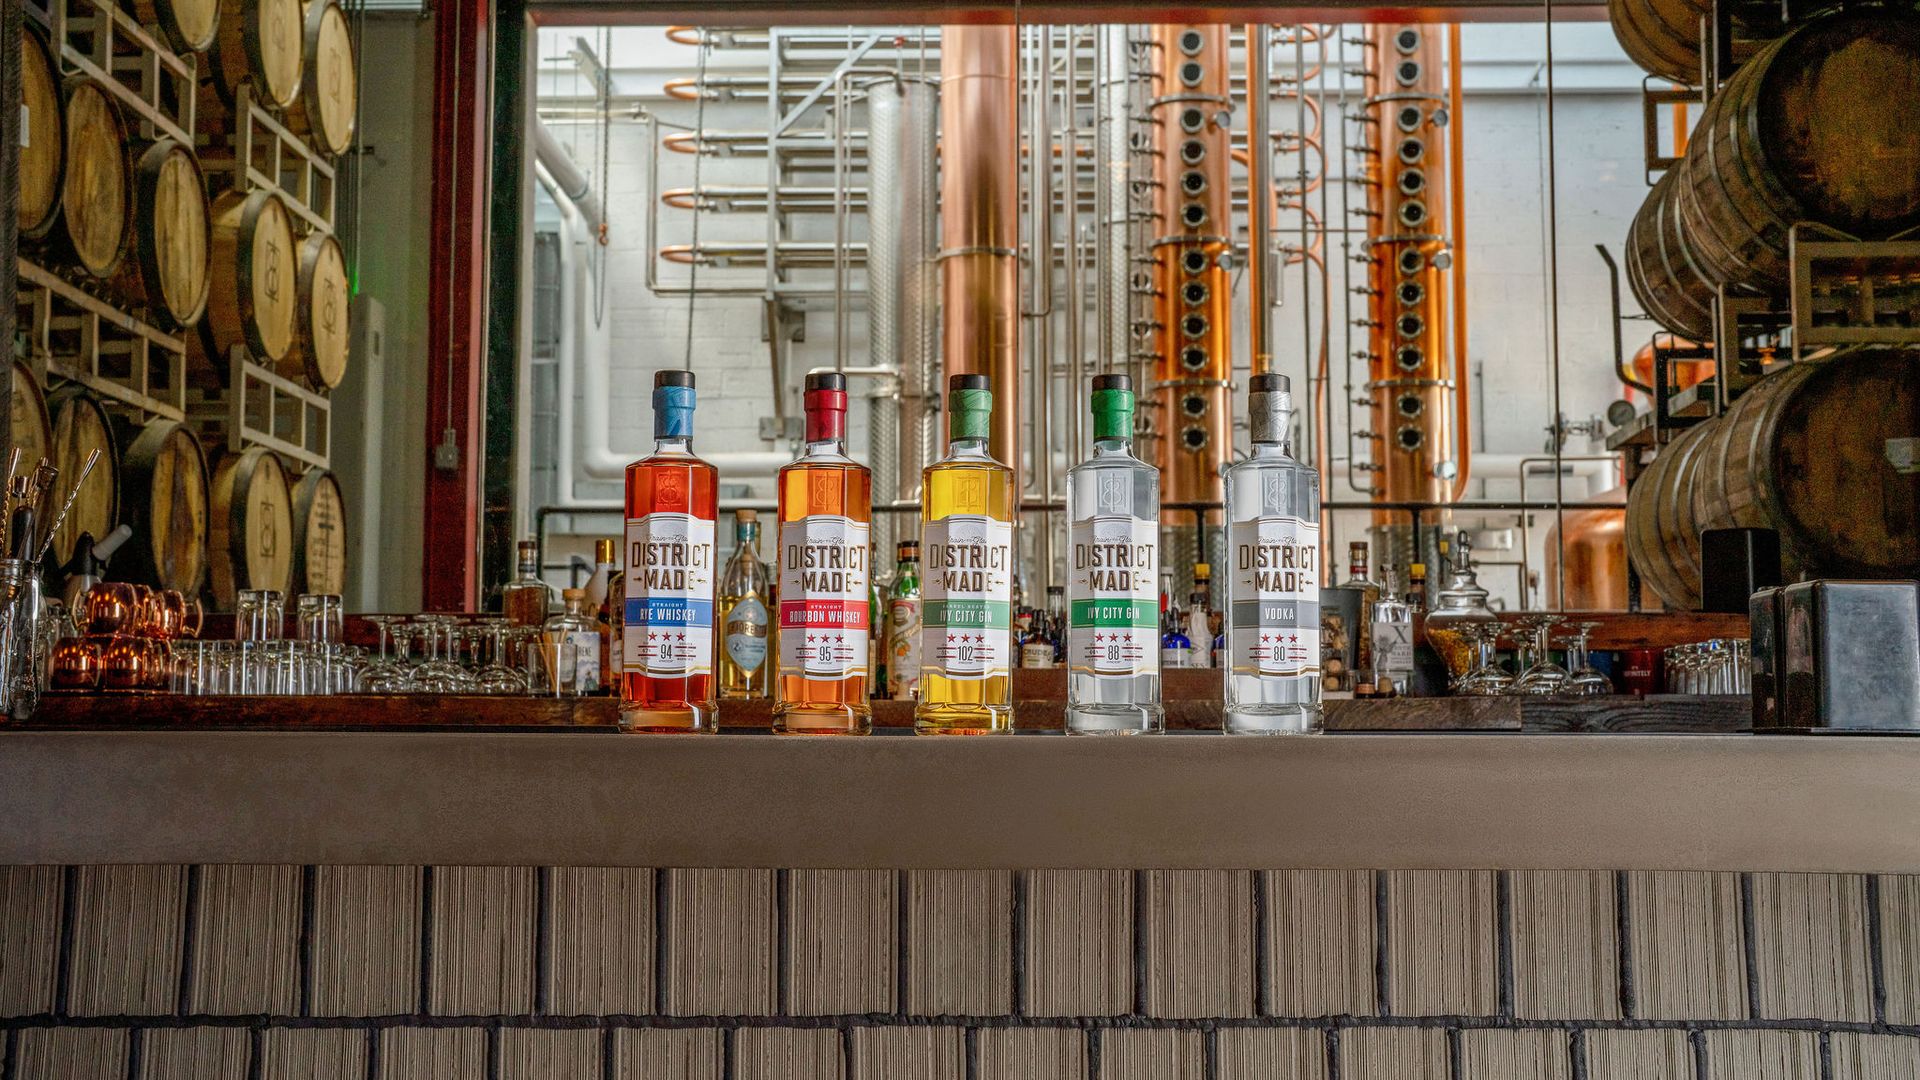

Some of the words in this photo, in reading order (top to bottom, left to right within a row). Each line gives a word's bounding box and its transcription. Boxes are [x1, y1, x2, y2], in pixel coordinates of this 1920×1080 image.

[631, 542, 710, 569] DISTRICT
[788, 544, 865, 571] DISTRICT
[930, 544, 1007, 571] DISTRICT
[1076, 544, 1153, 569] DISTRICT
[1239, 544, 1315, 571] DISTRICT
[644, 568, 696, 591] MADE
[801, 571, 852, 593] MADE
[942, 571, 993, 592] MADE
[1089, 570, 1140, 591] MADE
[1254, 571, 1304, 592] MADE
[640, 608, 653, 620] RYE
[656, 608, 697, 621] WHISKEY
[789, 610, 825, 622] BOURBON
[828, 610, 861, 624] WHISKEY
[940, 610, 952, 622] IVY
[955, 610, 975, 622] CITY
[978, 610, 992, 623] GIN
[1087, 607, 1100, 619] IVY
[1103, 607, 1123, 619] CITY
[1126, 607, 1140, 619] GIN
[1265, 607, 1295, 620] VODKA
[660, 644, 672, 659] 94
[819, 646, 831, 661] 95
[958, 646, 973, 661] 102
[1107, 645, 1120, 660] 88
[1273, 646, 1285, 661] 80
